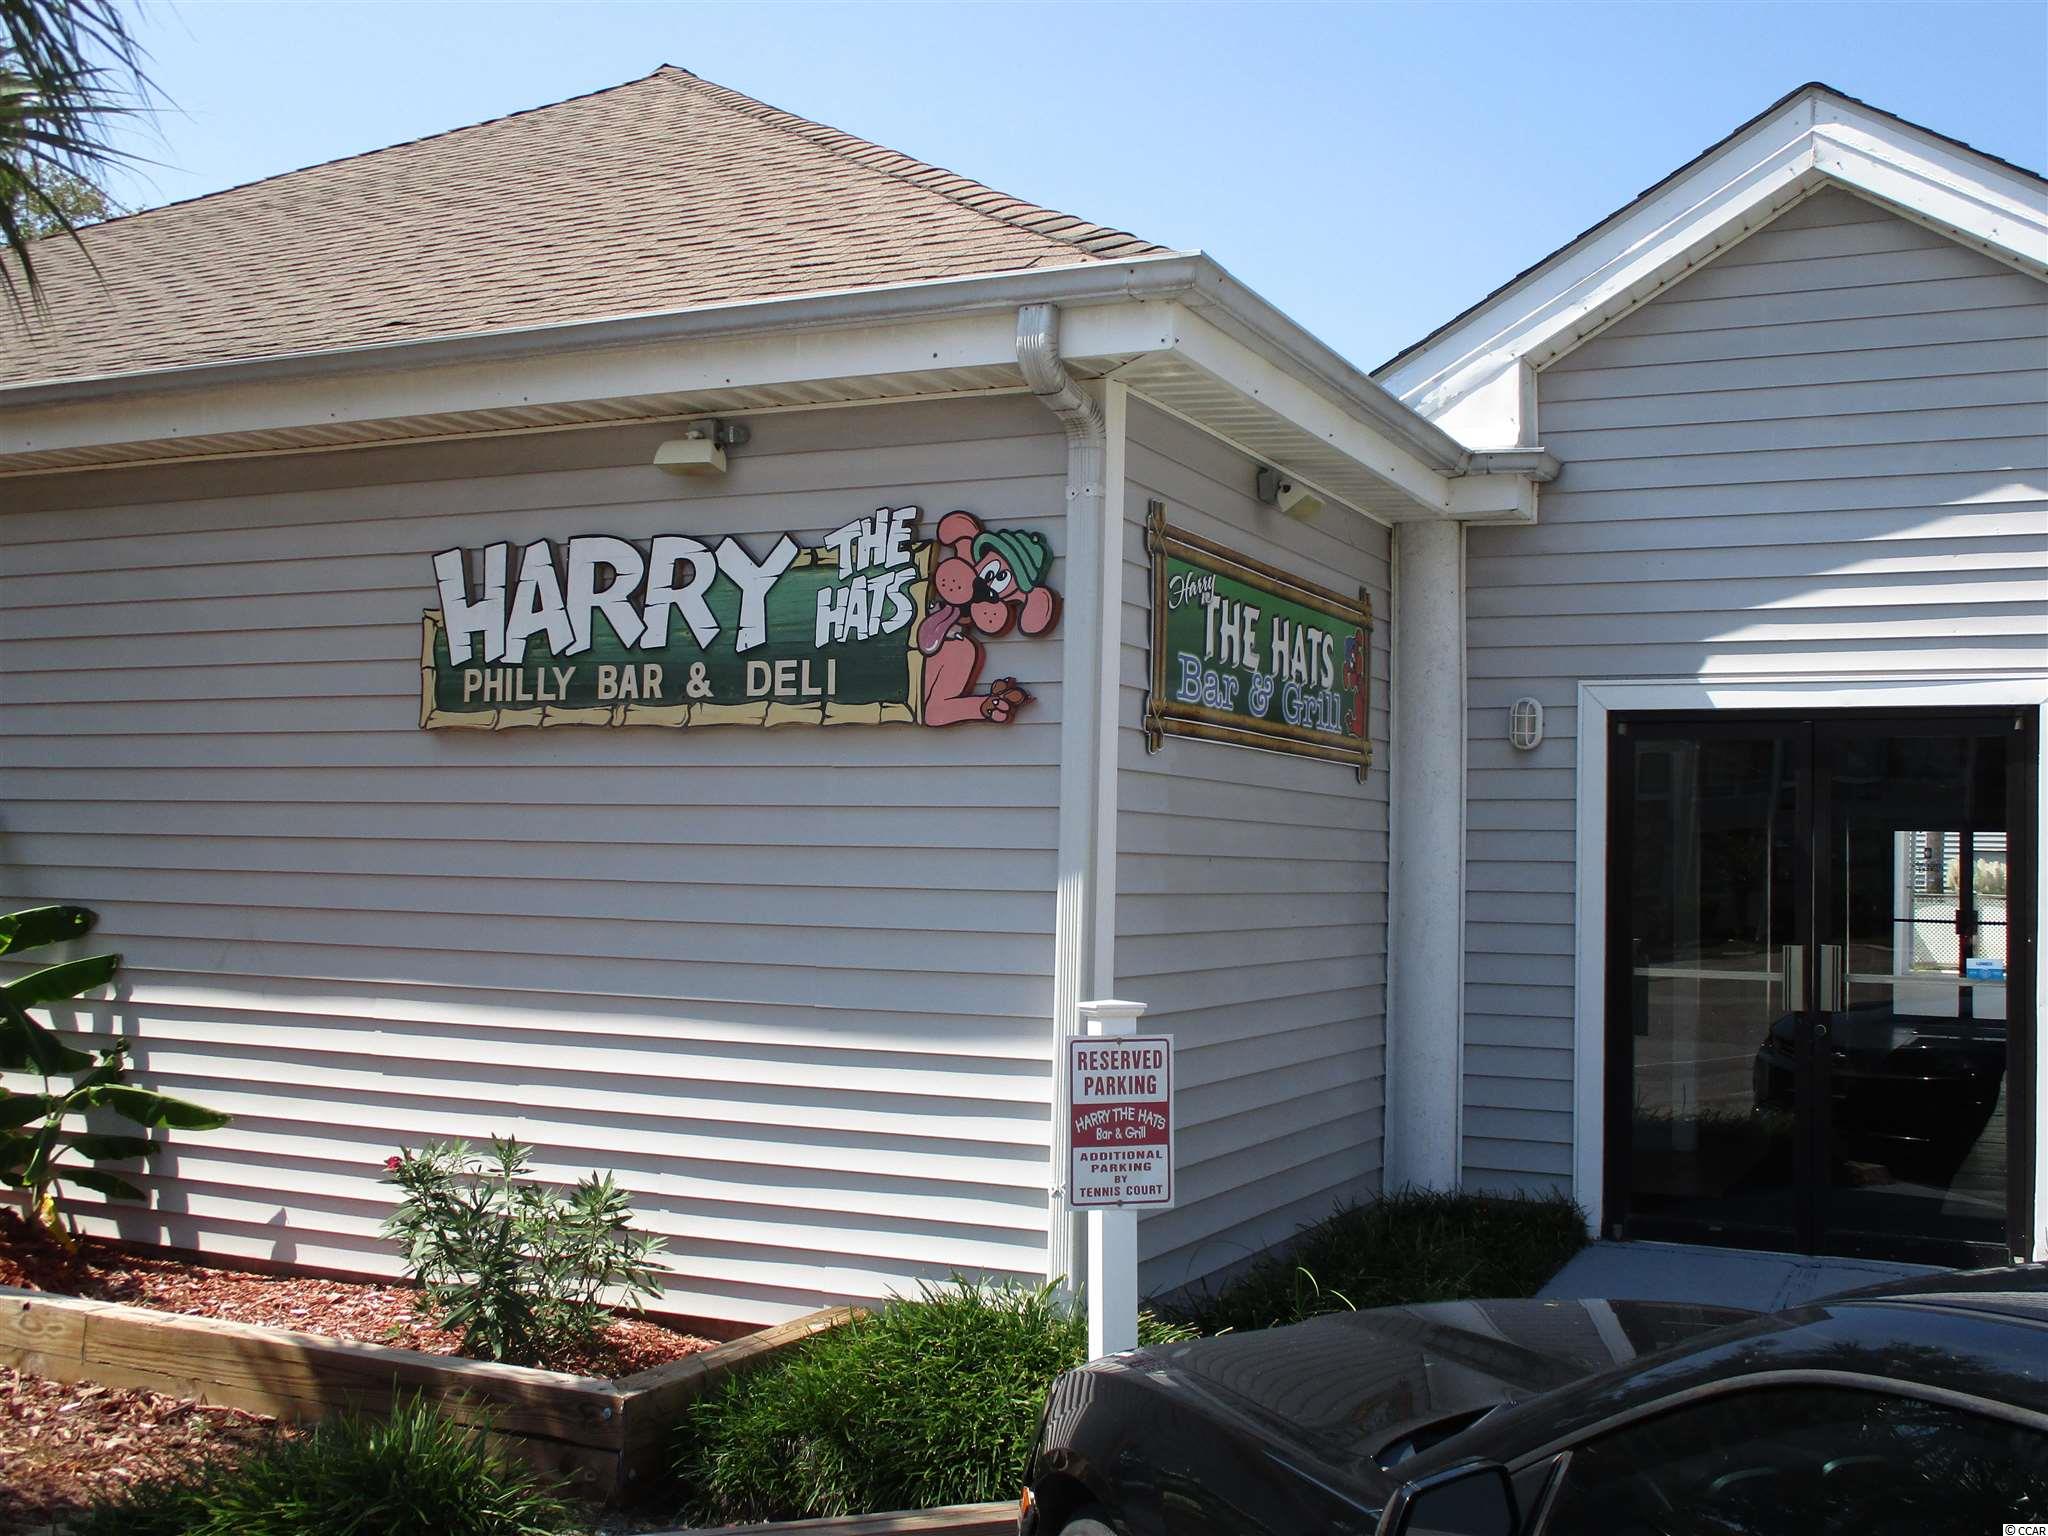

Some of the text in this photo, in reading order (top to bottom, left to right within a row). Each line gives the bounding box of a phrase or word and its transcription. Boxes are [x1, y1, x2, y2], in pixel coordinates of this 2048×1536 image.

[824, 507, 917, 579] THE
[433, 535, 800, 667] HARRY
[1169, 571, 1216, 609] Harry
[816, 569, 917, 649] HATS
[1201, 591, 1334, 690] THE HATS
[463, 658, 837, 703] PHILLY BAR & DELI
[1177, 652, 1342, 734] Bar & Grill
[1078, 1050, 1163, 1071] RESERVED
[1084, 1075, 1157, 1096] PARKING
[1075, 1107, 1166, 1133] HARRY THE HATS
[1096, 1126, 1146, 1141] Bar & Grill
[1080, 1150, 1163, 1162] ADDITIONAL
[1091, 1162, 1152, 1173] PARKING
[1080, 1184, 1163, 1198] TENNIS COURT
[1114, 1175, 1128, 1184] BY
